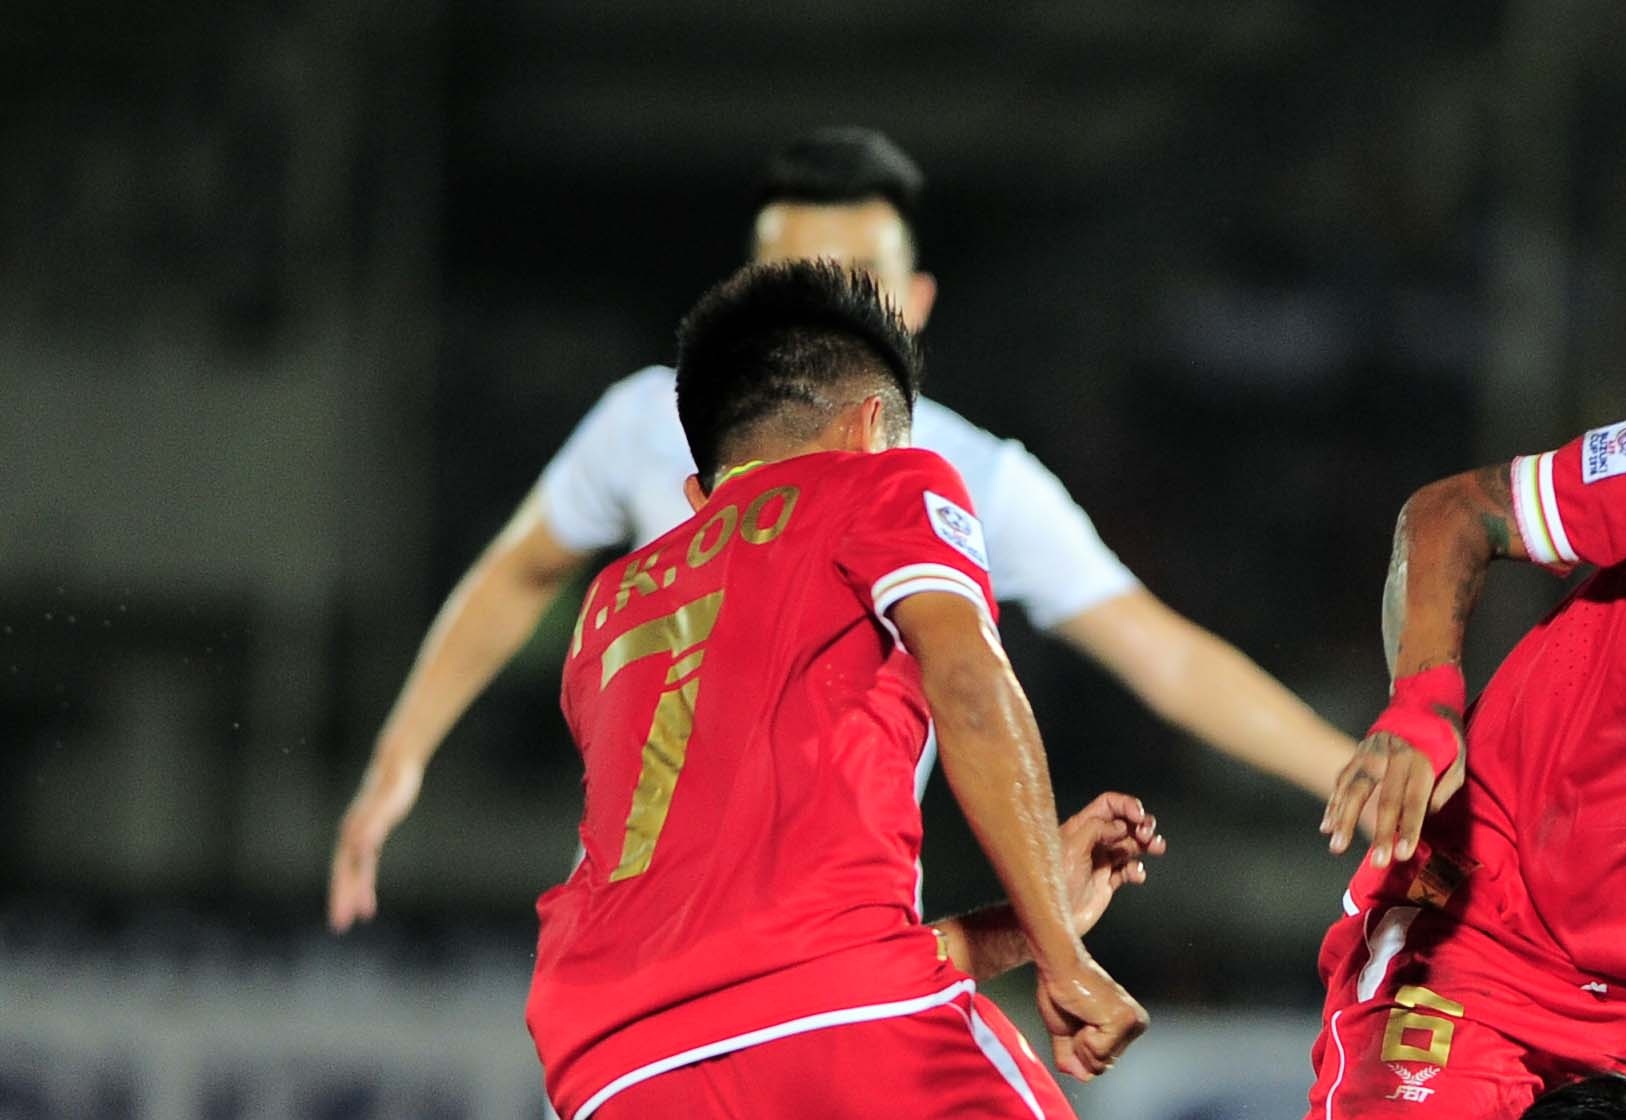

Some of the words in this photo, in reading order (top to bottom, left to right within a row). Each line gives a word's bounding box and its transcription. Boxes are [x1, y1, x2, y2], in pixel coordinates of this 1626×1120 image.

[601, 587, 726, 883] 7
[1381, 984, 1465, 1067] 6
[1385, 1085, 1435, 1103] FBT
